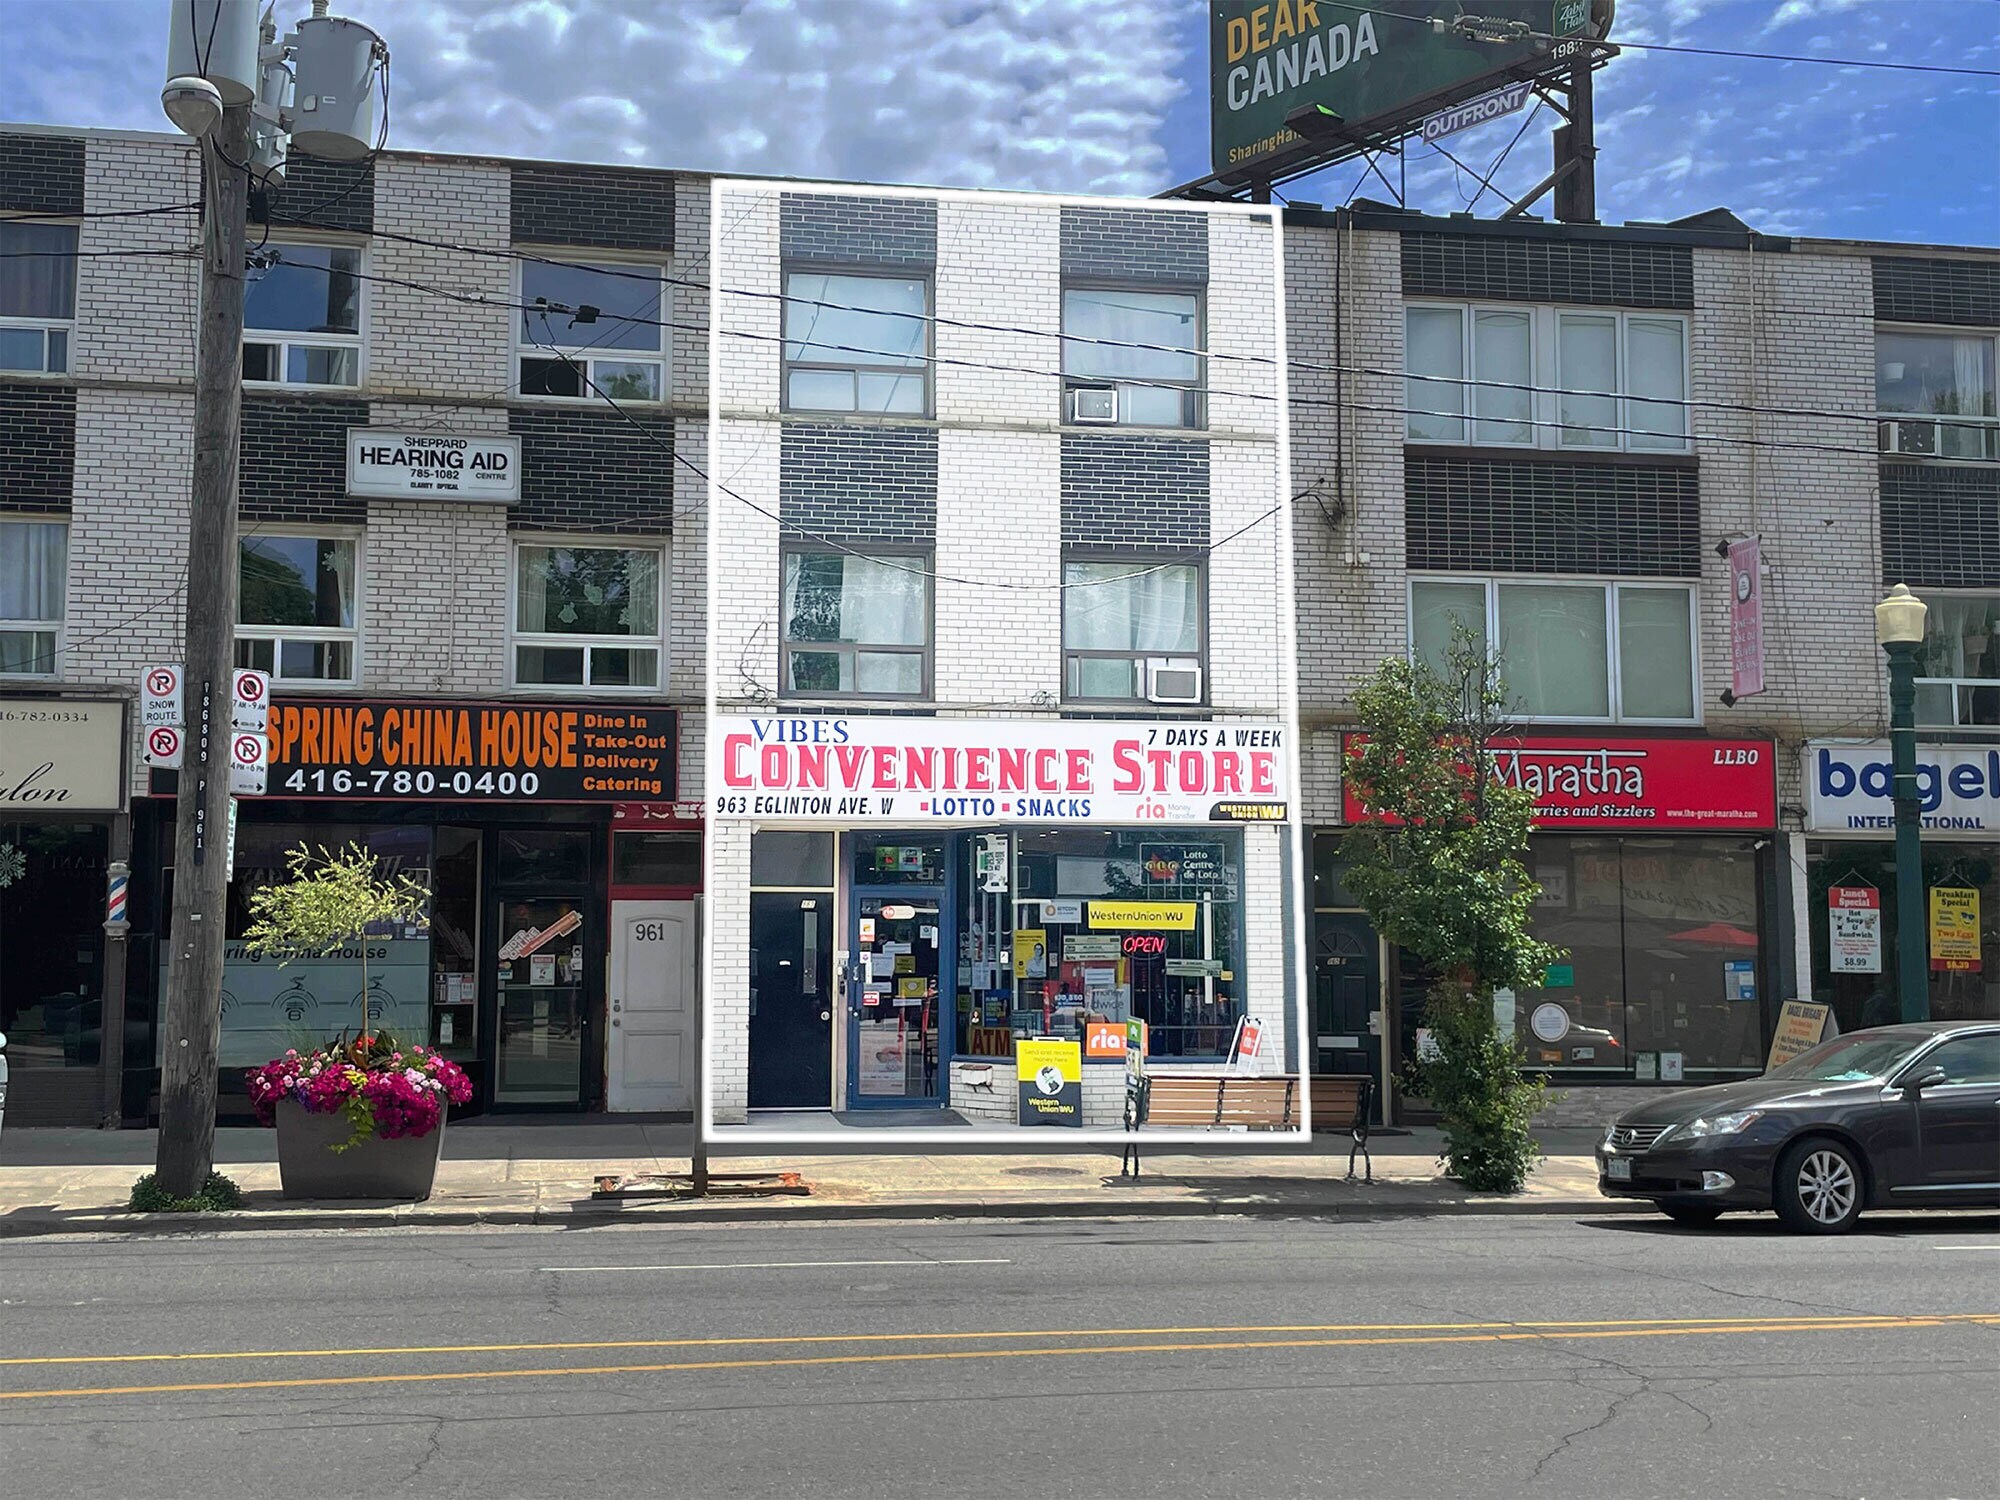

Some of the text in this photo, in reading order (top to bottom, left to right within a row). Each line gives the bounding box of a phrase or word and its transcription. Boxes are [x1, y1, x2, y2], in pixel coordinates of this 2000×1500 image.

[1227, 0, 1321, 64] DEAR
[1227, 12, 1380, 112] CANADA
[1426, 88, 1524, 138] OUTFRONT
[404, 436, 467, 449] SHEPPARD
[360, 447, 508, 470] HEARING AID
[410, 469, 459, 480] 785-1082
[475, 472, 507, 480] CENTRE
[149, 700, 175, 709] SNOW
[146, 712, 177, 721] ROUTE
[584, 714, 648, 729] Dine In
[269, 706, 577, 768] SPRING CHINA HOUSE
[750, 719, 849, 743] VIBES
[1148, 729, 1281, 748] 7 DAYS A WEEK
[583, 734, 667, 749] Take-Out
[583, 754, 659, 772] Delivery
[724, 733, 1277, 796] CONVENIENCE STORE
[1713, 749, 1759, 765] LLBO
[285, 769, 539, 796] 416-780-0400
[583, 777, 662, 794] Catering
[716, 796, 747, 814] 963
[754, 797, 831, 815] EGLINTON
[838, 798, 872, 815] AVE.
[882, 798, 894, 815] W
[932, 798, 995, 816] LOTTO
[1016, 798, 1091, 817] SNACKS
[1136, 797, 1165, 819] ria
[1168, 804, 1191, 812] Money
[1219, 804, 1258, 812] WESTERN
[1572, 805, 1598, 817] and
[1601, 804, 1656, 817] Sizzlers
[1231, 811, 1258, 819] UNION
[1666, 809, 1758, 819] www.the-great-maratha.com
[196, 809, 204, 848] 961
[1183, 850, 1208, 859] Lotto
[1183, 861, 1214, 869] Centre
[1183, 870, 1219, 879] de Loto
[1841, 889, 1868, 898] Lunch
[1936, 890, 1975, 899] Breakfast
[1839, 898, 1870, 907] Special
[1941, 899, 1970, 907] Special
[1090, 911, 1162, 922] WesternUnion
[635, 923, 664, 941] 961
[1838, 931, 1873, 939] Sandwich
[1123, 937, 1166, 953] OPEN
[972, 1029, 1010, 1056] ATM
[1091, 1028, 1120, 1048] ria
[1028, 1098, 1059, 1106] Western
